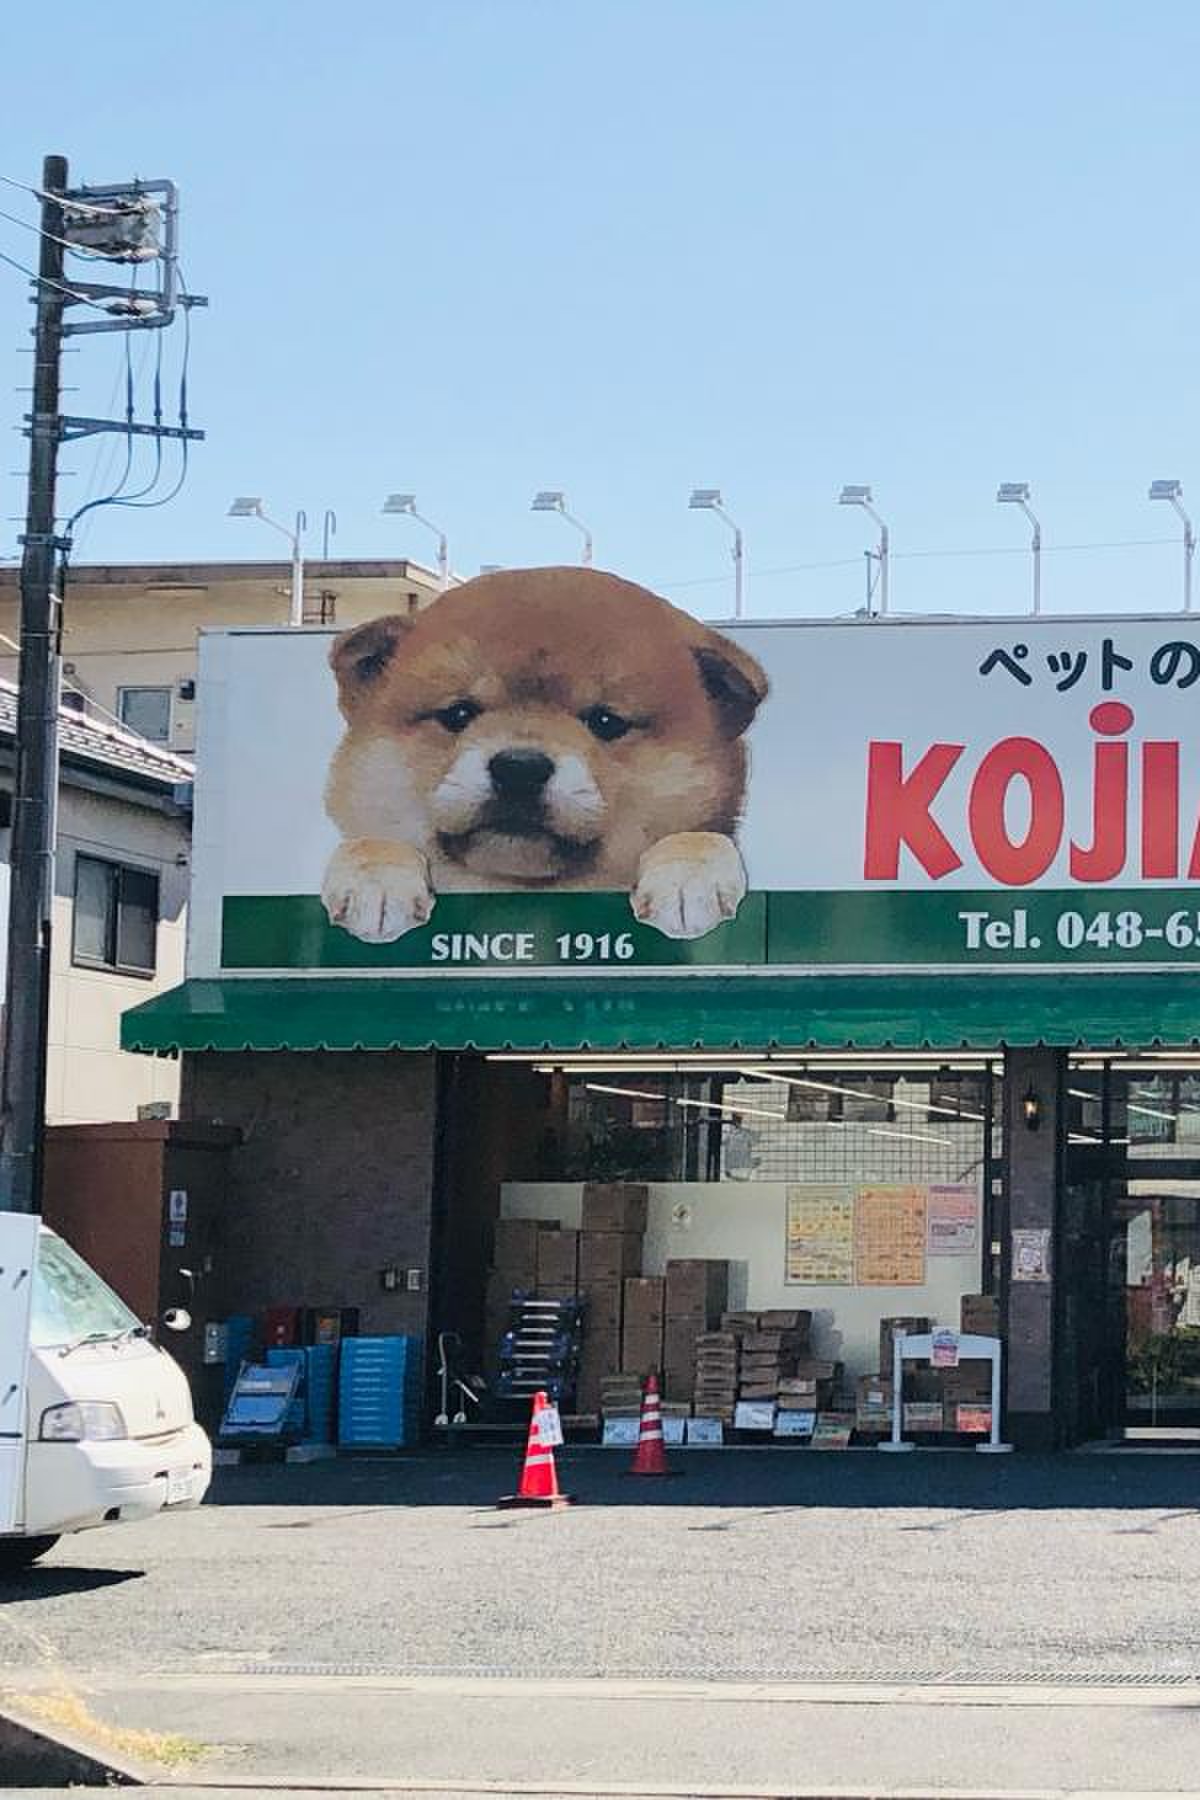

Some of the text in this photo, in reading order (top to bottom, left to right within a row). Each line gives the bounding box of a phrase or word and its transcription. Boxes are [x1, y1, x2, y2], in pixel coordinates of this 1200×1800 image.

[431, 932, 635, 961] SINCE 1916
[958, 910, 1042, 949] Tel.
